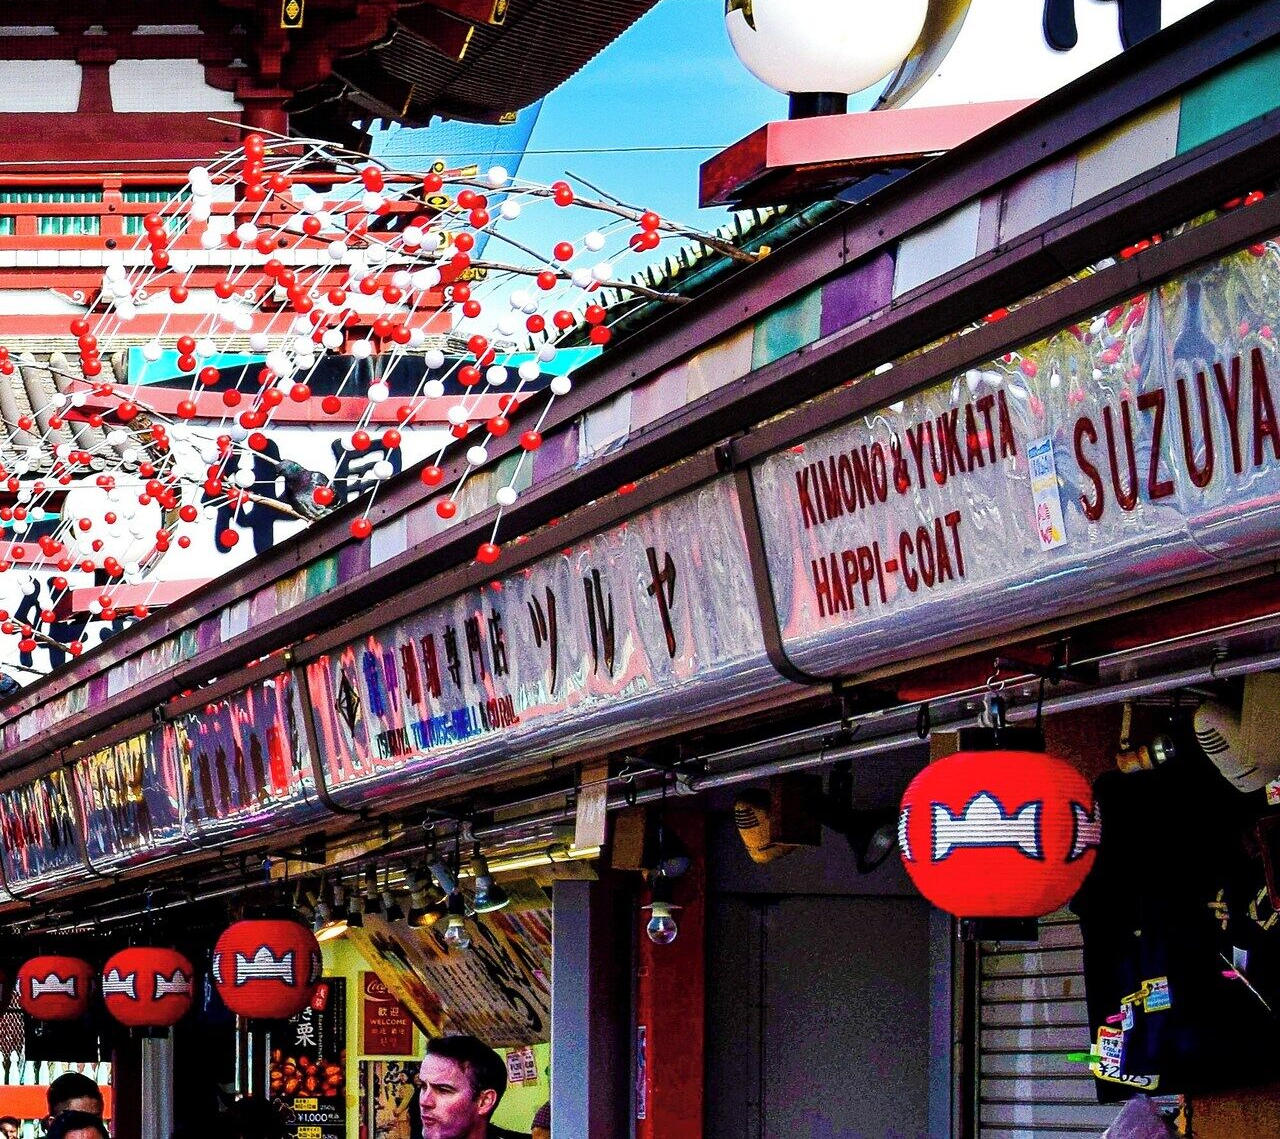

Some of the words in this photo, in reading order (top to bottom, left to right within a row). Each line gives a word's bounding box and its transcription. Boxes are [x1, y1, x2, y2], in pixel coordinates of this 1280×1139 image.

[795, 441, 888, 529] KIMONO
[890, 432, 911, 495] &
[906, 389, 1018, 489] YUKATA
[1073, 347, 1280, 521] SUZUYA
[526, 547, 677, 695] ツルヤ
[811, 510, 966, 618] HAPPI-COAT
[369, 1018, 408, 1026] WELCOME
